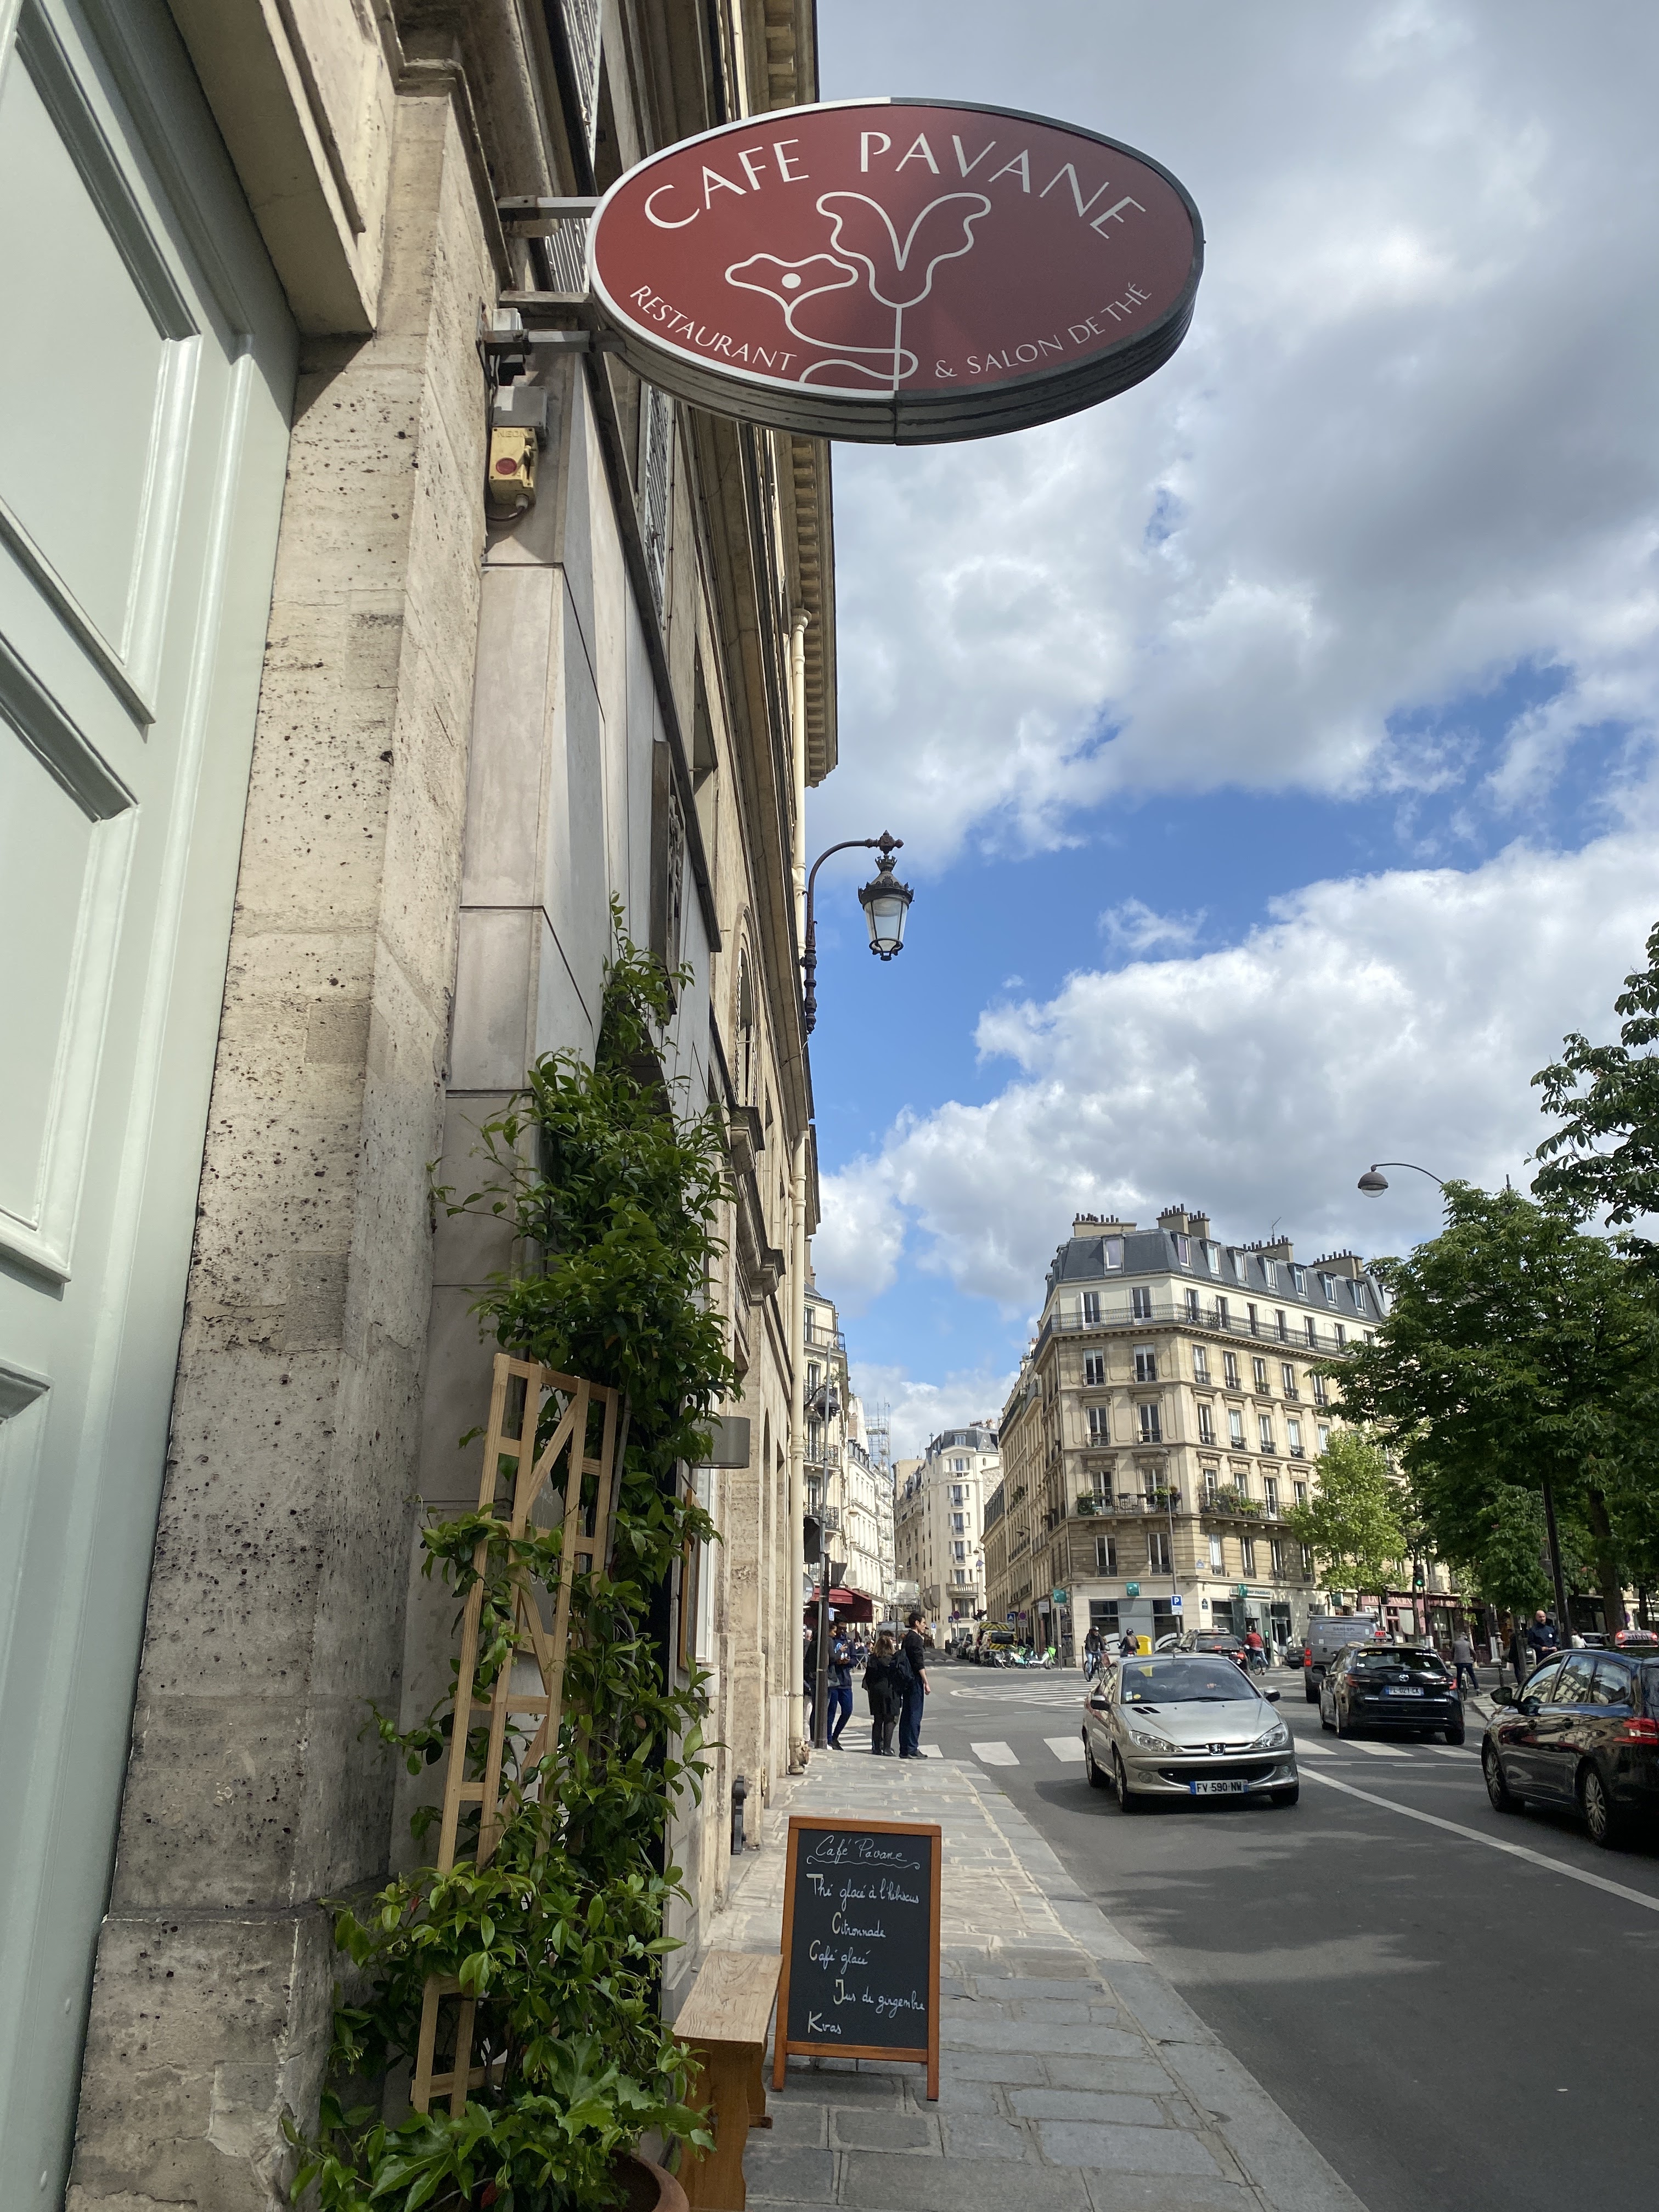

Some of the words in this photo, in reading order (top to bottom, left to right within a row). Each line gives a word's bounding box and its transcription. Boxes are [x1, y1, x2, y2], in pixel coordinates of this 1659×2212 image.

[644, 138, 810, 229] CAFE
[860, 131, 1146, 239] PAVANE
[629, 285, 798, 371] RESTAURANT
[935, 360, 958, 378] &
[967, 335, 1064, 374] SALON
[1068, 317, 1105, 344] DE
[1101, 282, 1152, 321] THÉ
[815, 1835, 852, 1864] Café
[854, 1838, 907, 1862] Pavane
[832, 1911, 887, 1938] Citronnade
[809, 1939, 838, 1970] Café
[840, 1946, 871, 1975] glacé
[833, 1979, 856, 2005] Jus
[862, 1985, 874, 2004] de
[875, 1990, 925, 2018] gingembre
[807, 2011, 842, 2034] Kvas
